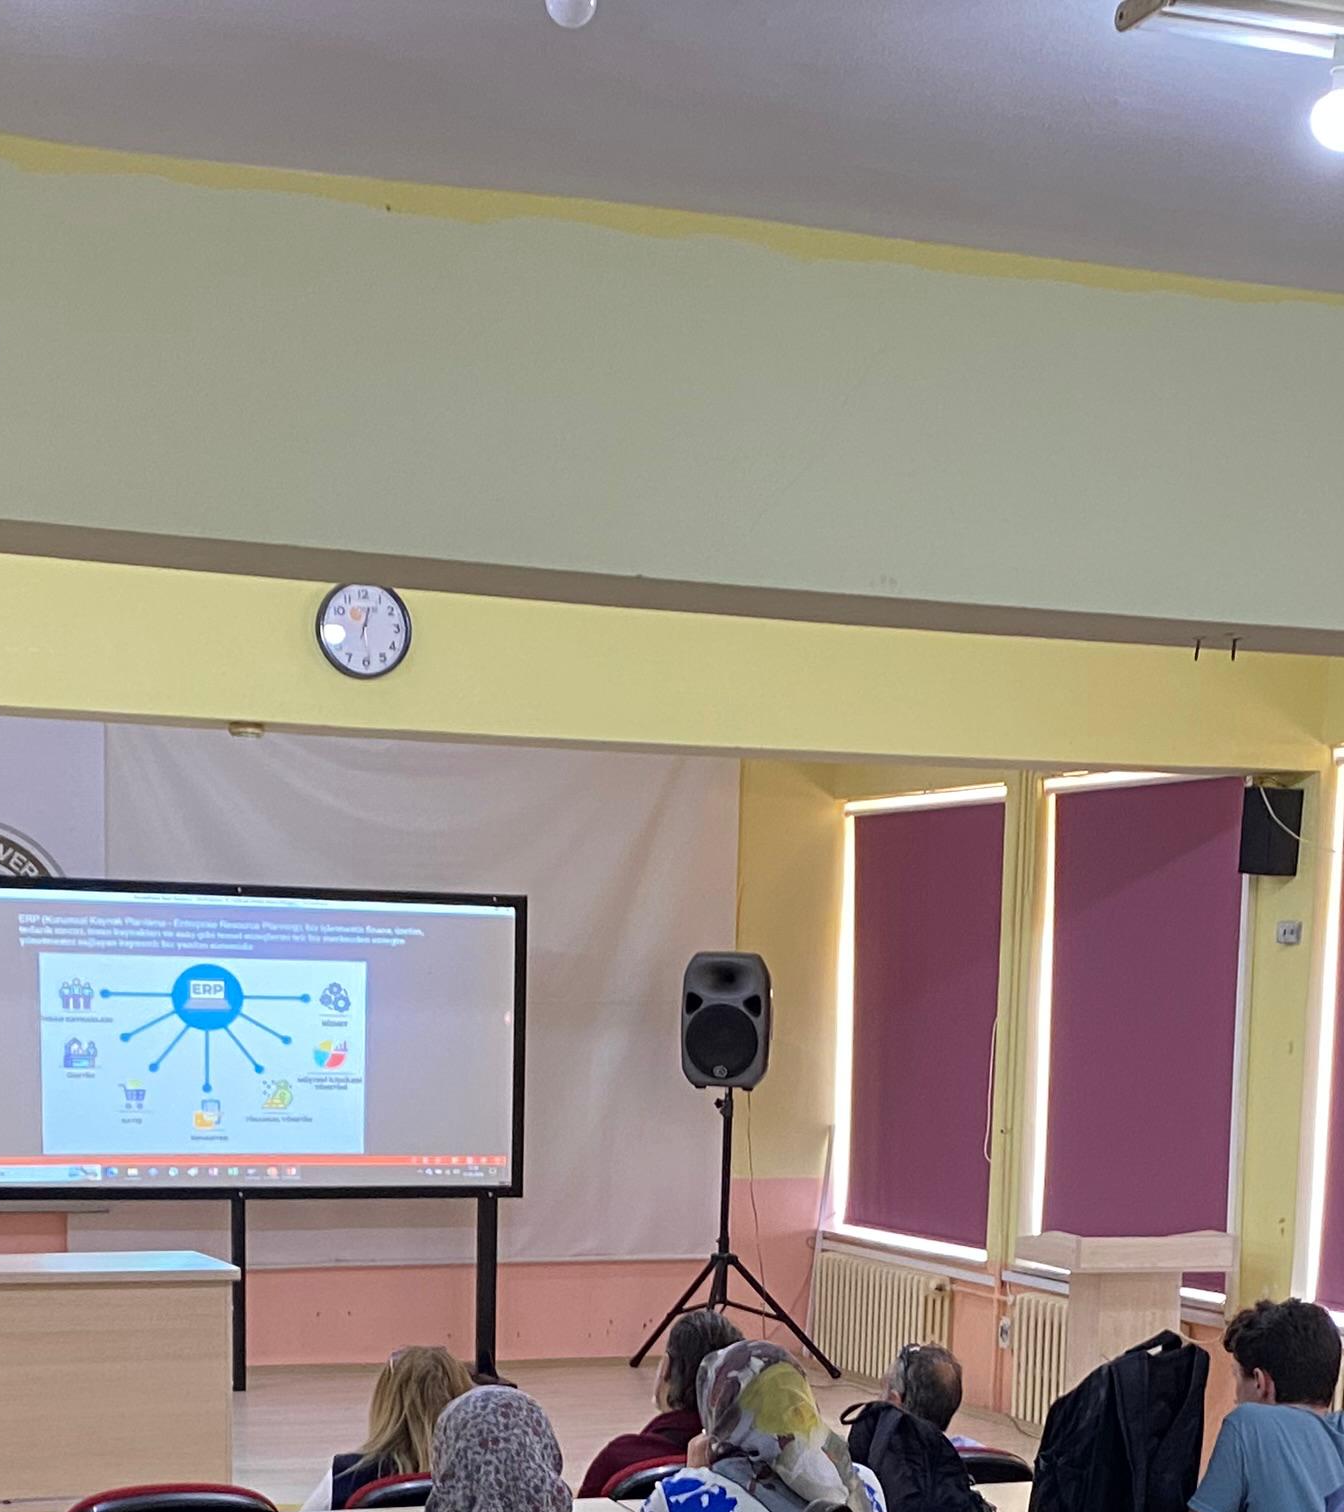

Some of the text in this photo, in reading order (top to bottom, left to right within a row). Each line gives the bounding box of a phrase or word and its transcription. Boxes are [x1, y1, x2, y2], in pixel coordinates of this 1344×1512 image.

[344, 594, 351, 605] 11
[358, 589, 369, 600] 12
[333, 606, 346, 616] 10
[387, 605, 395, 616] 2
[392, 623, 401, 634] 3
[388, 640, 396, 651] 4
[345, 652, 353, 664] 7
[362, 656, 371, 667] 6
[379, 652, 387, 663] 5
[191, 983, 224, 996] ERP
